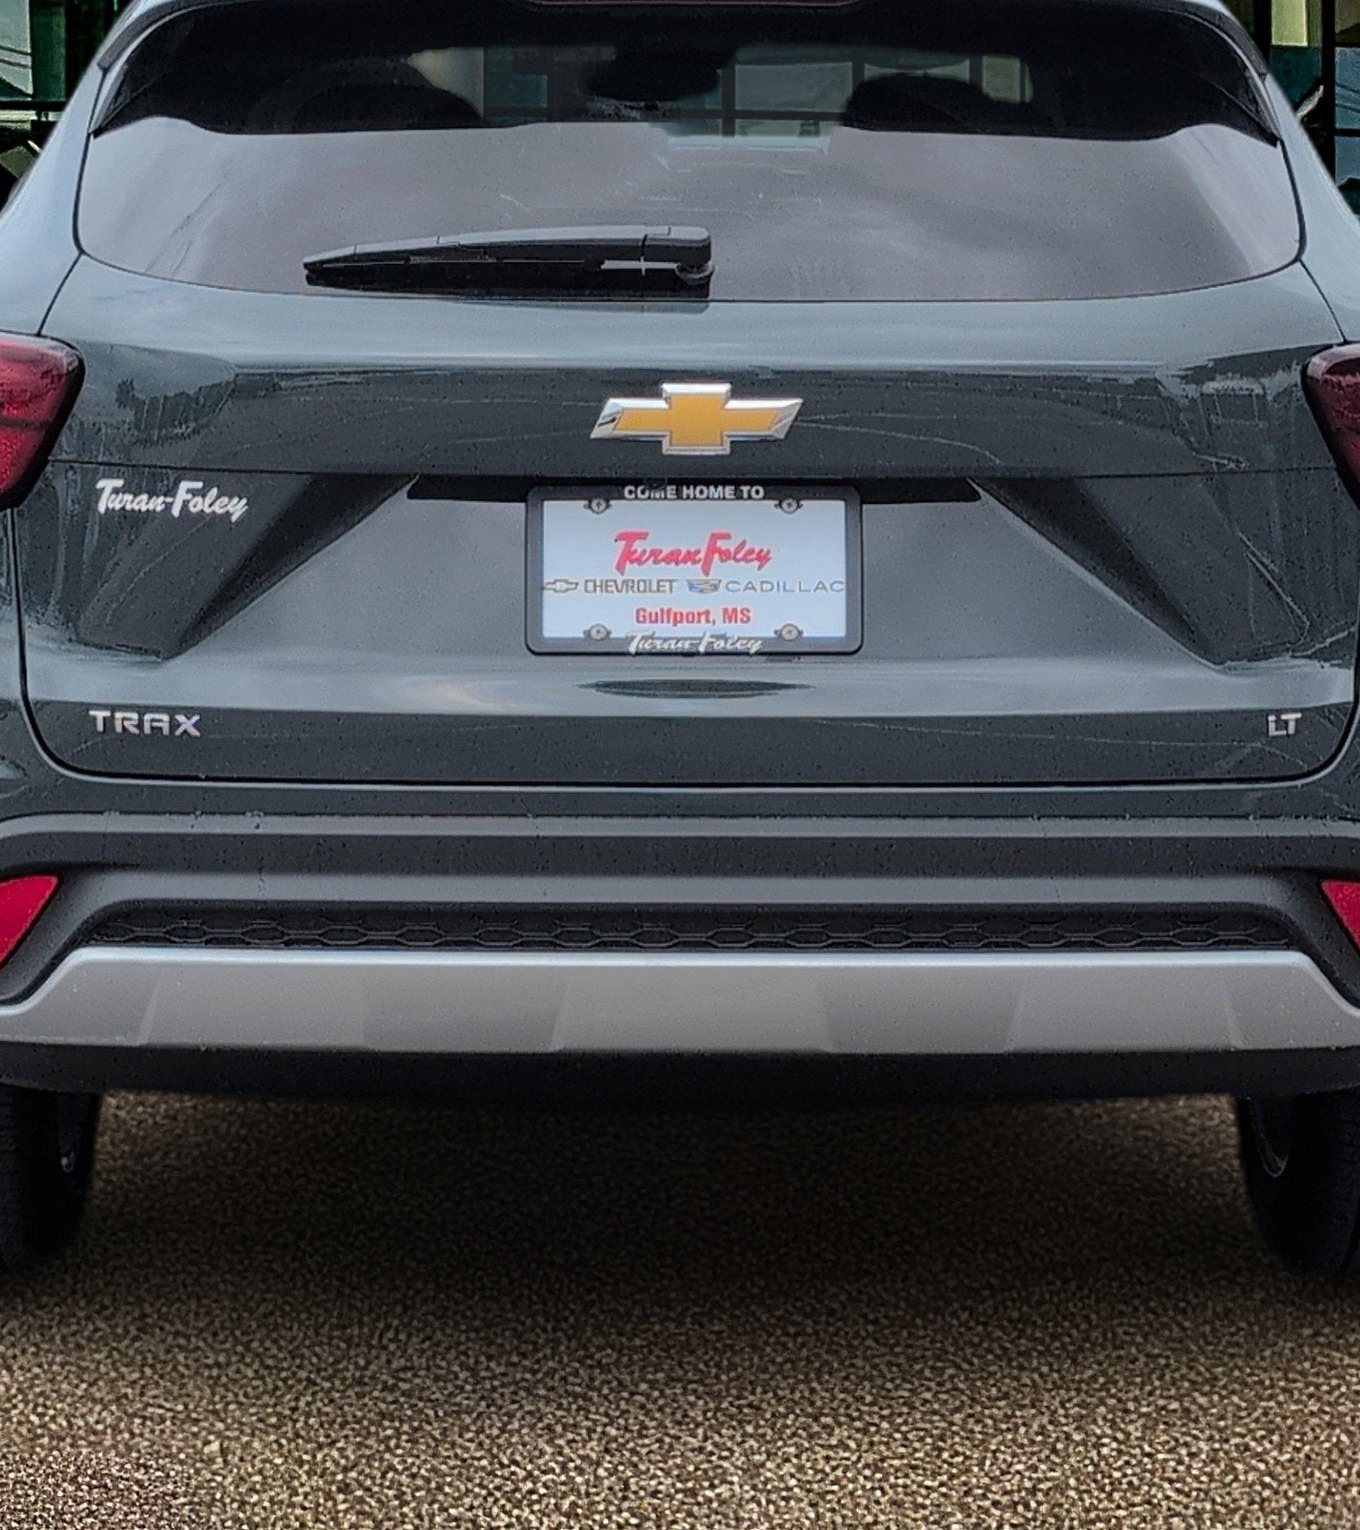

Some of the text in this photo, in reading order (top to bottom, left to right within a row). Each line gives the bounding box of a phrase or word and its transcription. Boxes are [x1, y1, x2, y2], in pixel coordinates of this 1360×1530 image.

[682, 484, 737, 500] HOME
[740, 484, 766, 500] TO
[615, 530, 773, 578] Turan Foley
[583, 578, 846, 595] CHEVROLET CADILLAC
[634, 606, 752, 627] Gulfport, MS
[88, 709, 202, 738] TRAX
[1267, 711, 1303, 737] LT
